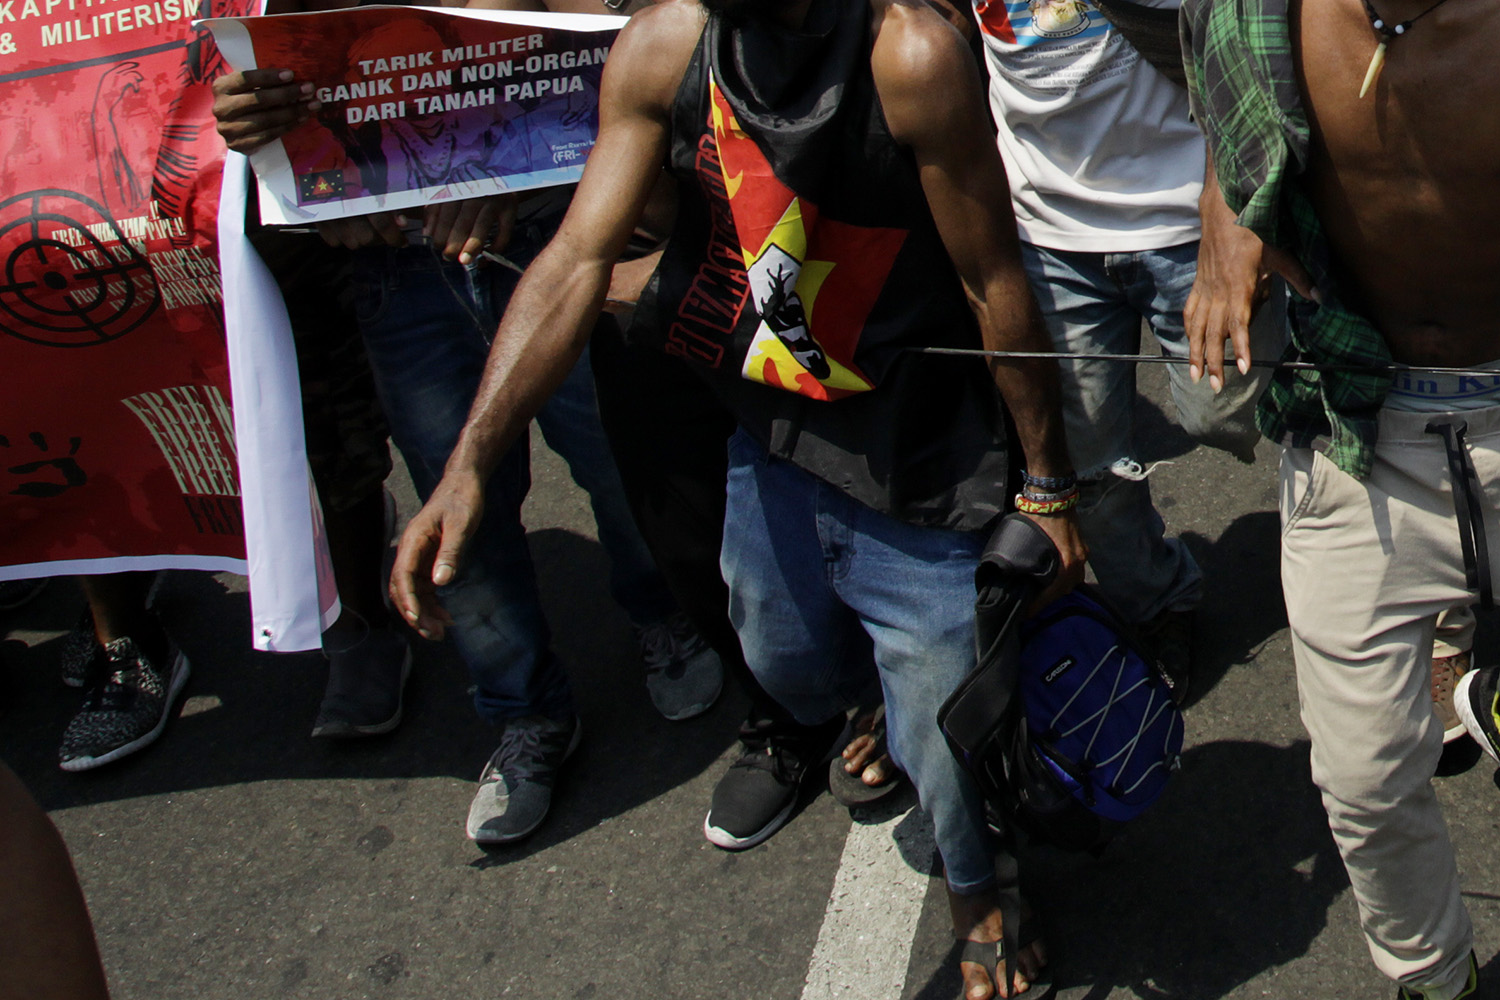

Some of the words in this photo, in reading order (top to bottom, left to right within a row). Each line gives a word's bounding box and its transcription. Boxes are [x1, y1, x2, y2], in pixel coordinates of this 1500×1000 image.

[0, 32, 17, 55] &
[359, 51, 433, 76] TARIK
[442, 33, 544, 63] MILITER
[402, 70, 452, 92] DAN
[347, 100, 406, 125] DARI
[414, 87, 495, 115] TANAH
[505, 75, 584, 102] PAPUA
